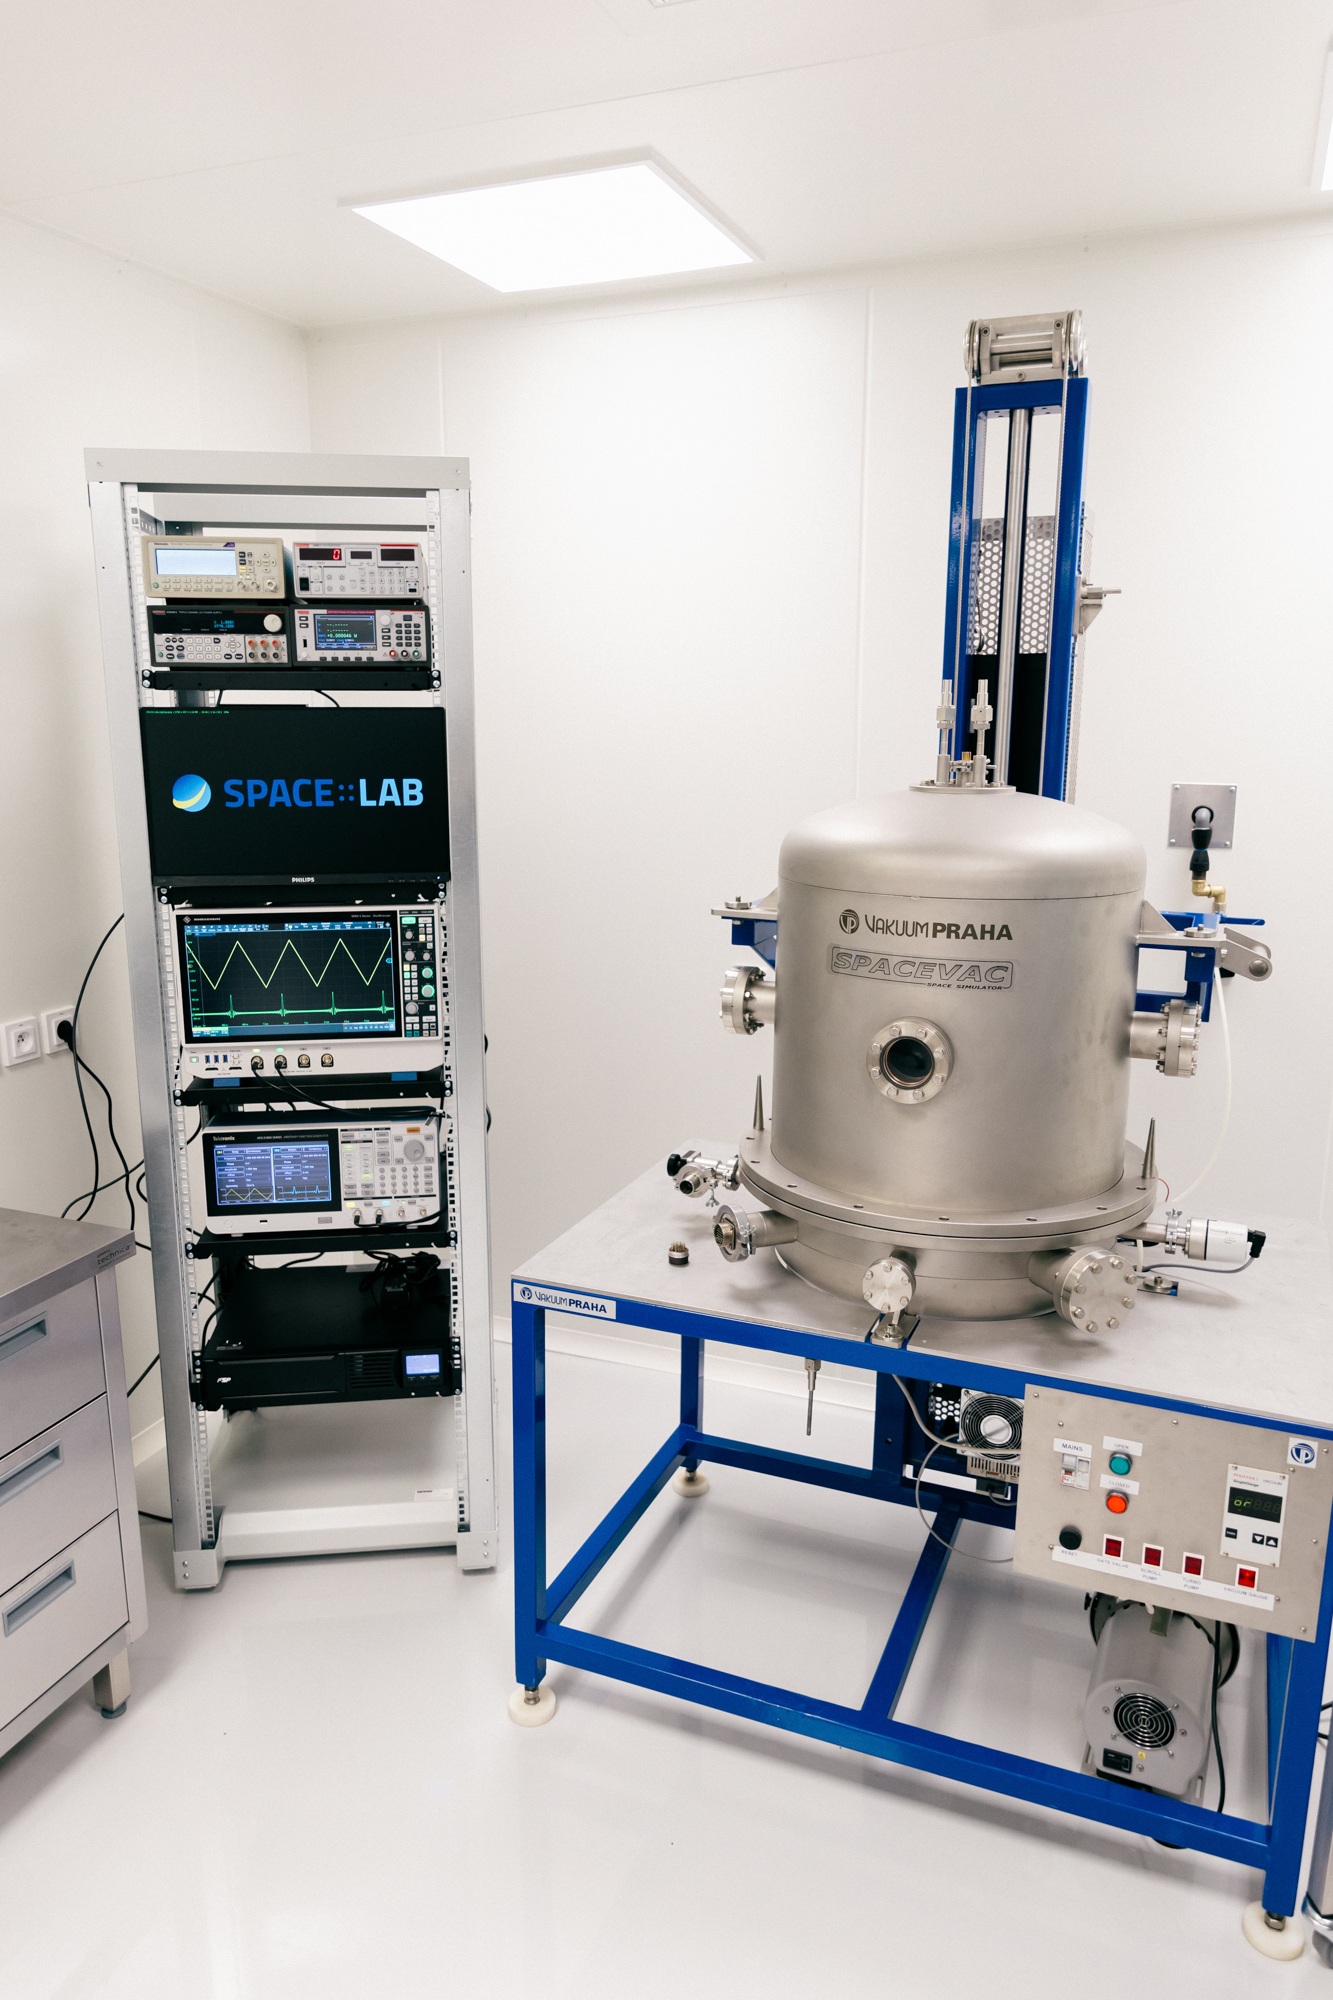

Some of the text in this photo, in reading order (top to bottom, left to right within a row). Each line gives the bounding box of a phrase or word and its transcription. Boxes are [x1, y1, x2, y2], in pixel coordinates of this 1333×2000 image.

[333, 548, 341, 560] 0
[864, 914, 1014, 941] VAKUUM PRAHA
[833, 951, 1009, 984] SPACEVAC
[534, 1290, 607, 1313] VAKUUM PRAHA
[1061, 1443, 1083, 1452] MAINS
[1114, 1442, 1129, 1450] OPEN
[1108, 1480, 1130, 1489] CLOSED
[1061, 1549, 1078, 1557] RESET
[1112, 1561, 1129, 1569] VALVE
[1140, 1567, 1161, 1576] SCROLL
[1183, 1577, 1202, 1585] TURBO
[1223, 1586, 1268, 1600] VACUUM GAUGE
